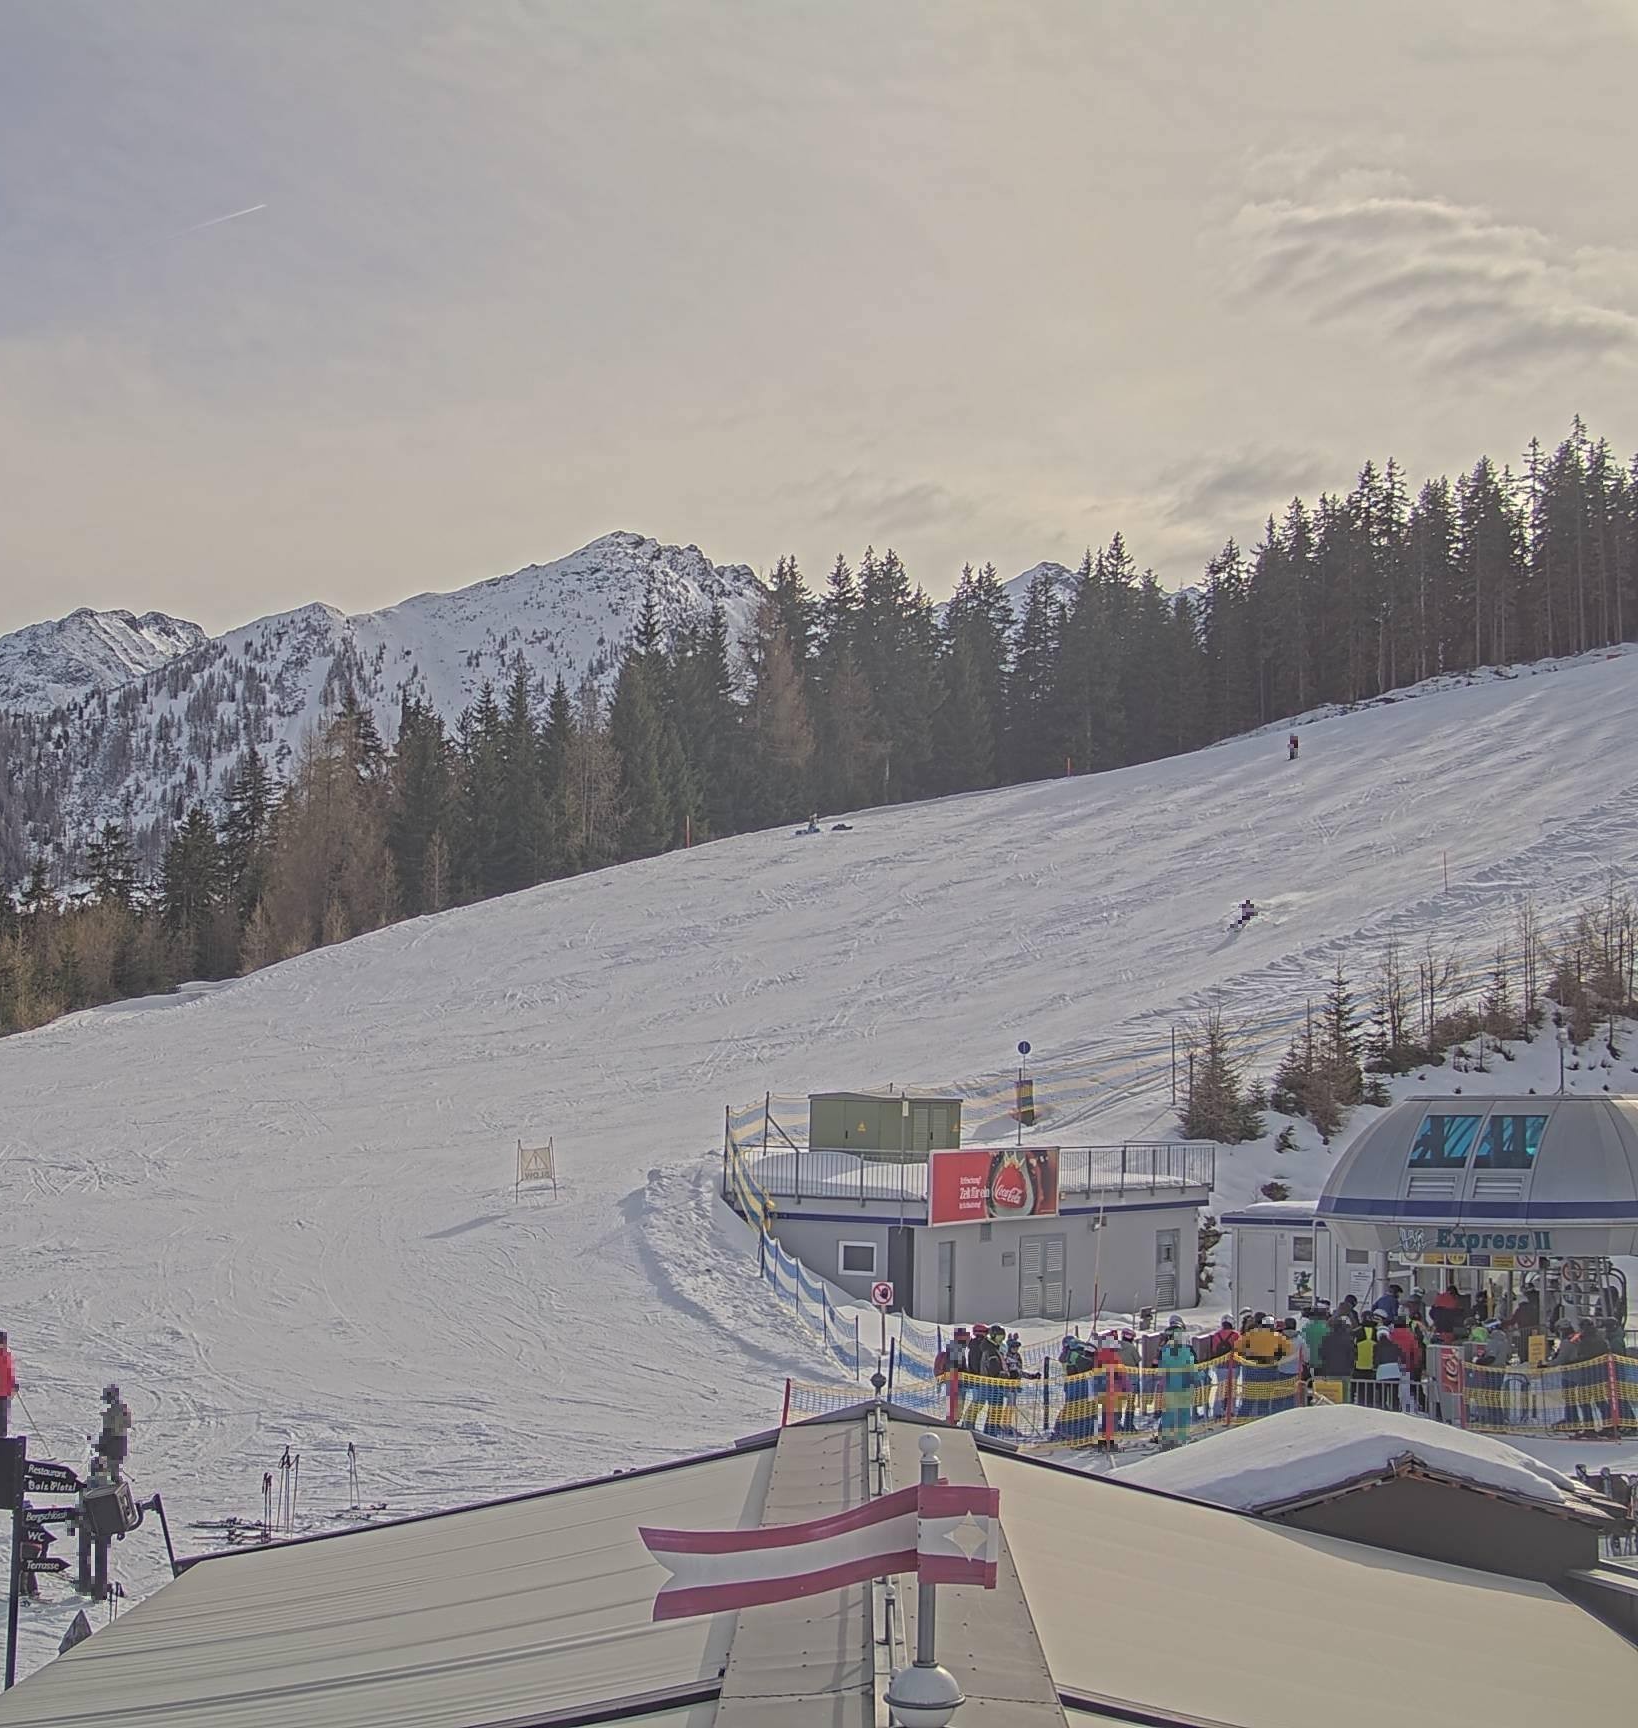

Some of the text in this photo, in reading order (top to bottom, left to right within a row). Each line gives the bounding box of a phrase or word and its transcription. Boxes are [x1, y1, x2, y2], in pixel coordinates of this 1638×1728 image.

[1436, 1228, 1529, 1253] Express
[28, 1530, 45, 1542] WC
[27, 1560, 60, 1570] Terrasse
